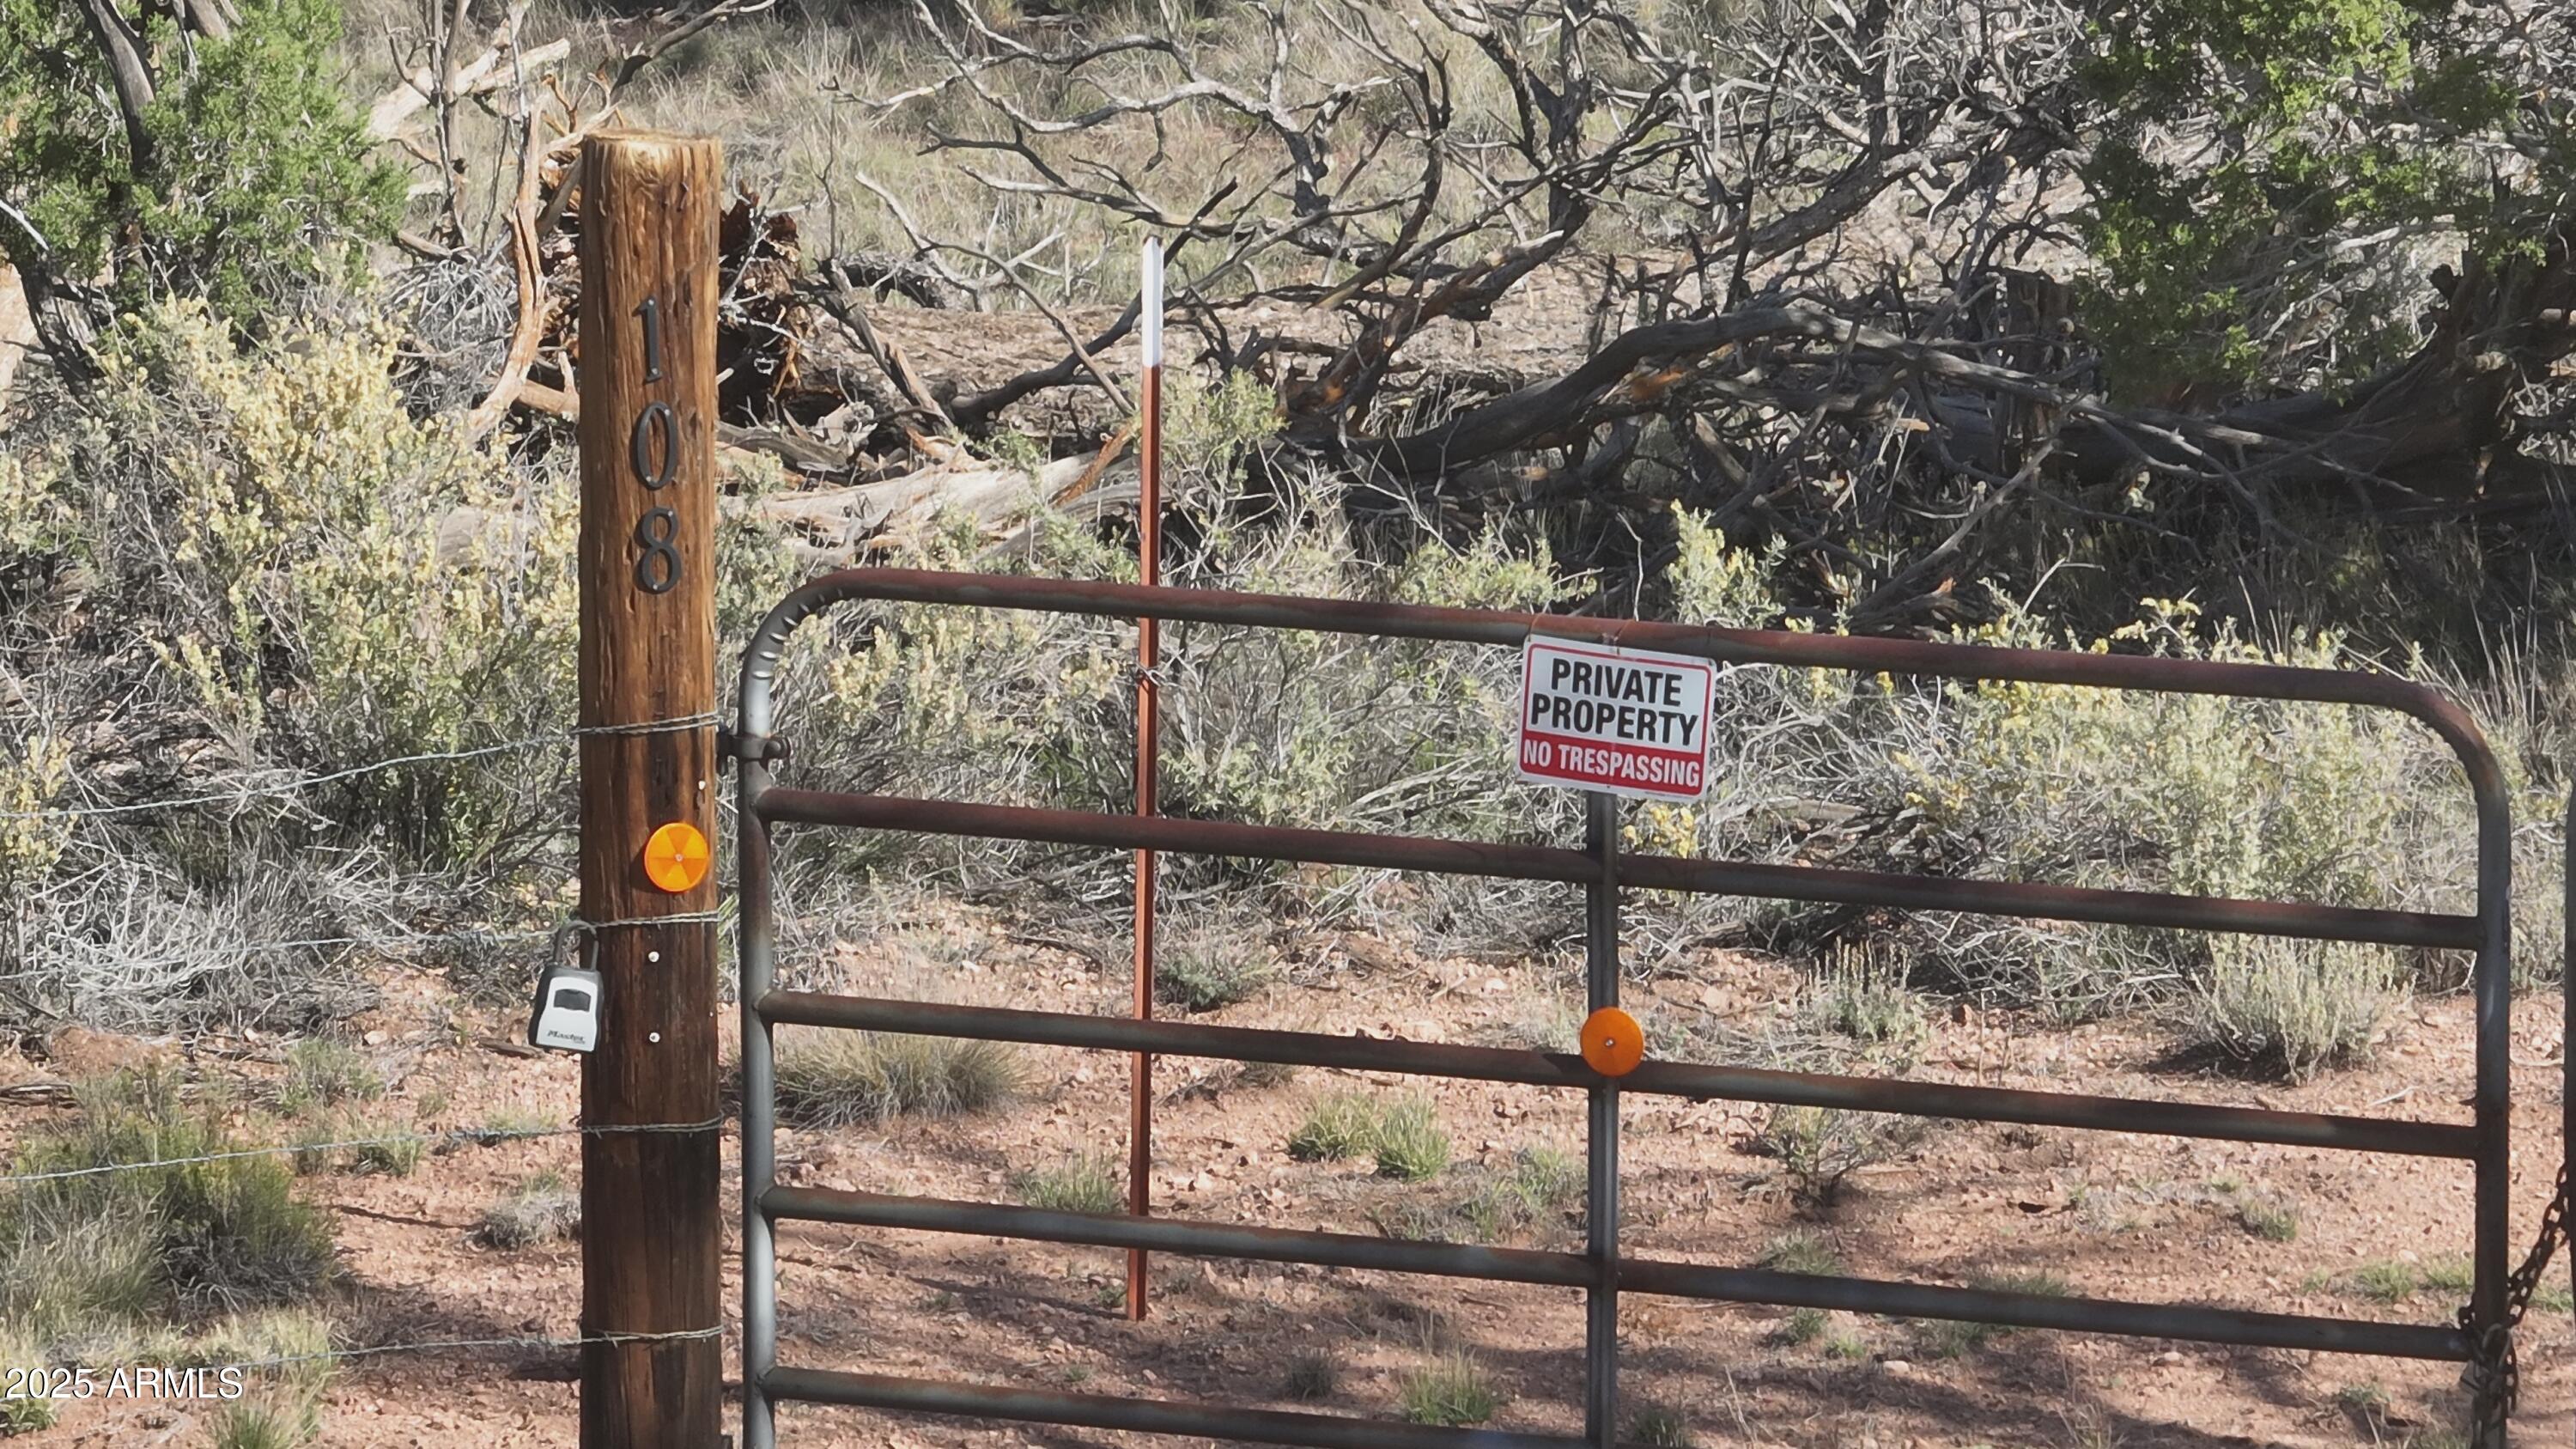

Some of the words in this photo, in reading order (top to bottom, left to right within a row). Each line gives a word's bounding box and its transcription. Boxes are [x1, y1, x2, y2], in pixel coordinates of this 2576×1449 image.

[634, 296, 682, 594] 108
[1551, 658, 1683, 707] PRIVATE
[1530, 692, 1698, 746] PROPERTY
[1523, 739, 1552, 767] NO
[1558, 744, 1700, 788] TRESPASSING
